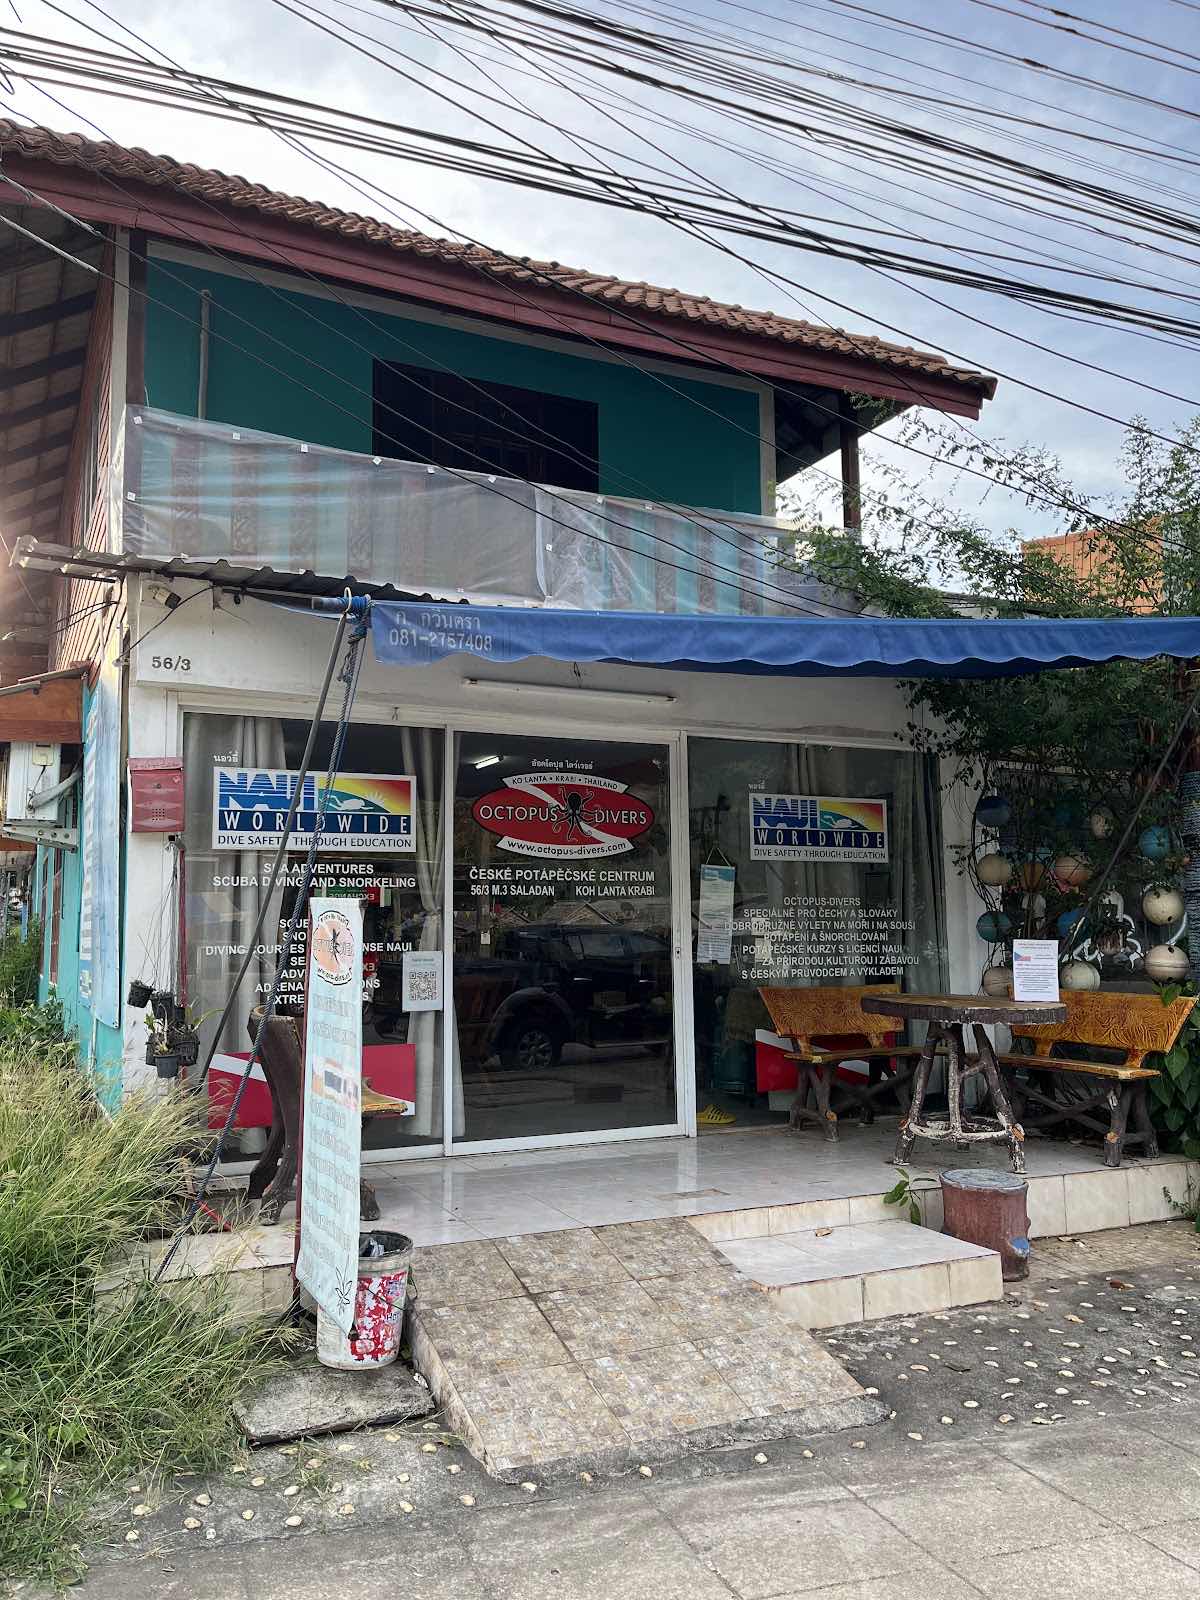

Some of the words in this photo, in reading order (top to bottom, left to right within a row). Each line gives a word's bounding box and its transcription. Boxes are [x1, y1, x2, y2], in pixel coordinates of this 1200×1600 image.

[390, 629, 492, 651] 081-2757408
[152, 656, 191, 671] 56/3
[584, 778, 618, 790] THAILAND
[479, 805, 559, 822] OCTOPUS
[595, 810, 647, 825] DIVERS
[753, 798, 817, 829] NAUI
[224, 811, 408, 834] WORLDWIDE
[218, 835, 244, 845] DIVE
[248, 836, 283, 846] SAFET
[351, 838, 411, 848] EDUCATION
[758, 829, 884, 847] WORLDWIDE
[507, 841, 627, 857] www.octopus-divers.com
[754, 848, 772, 856] DIVE
[774, 849, 801, 857] SAFETY
[804, 850, 841, 858] THROUGH
[843, 851, 886, 859] EDUCATION
[264, 863, 288, 873] SA
[292, 863, 374, 874] ADVENTURES
[469, 866, 512, 880] ČESKÉ
[516, 868, 597, 881] POTÁPĚČSKÉ
[600, 871, 655, 881] CENTRUM
[213, 876, 258, 887] SCUBA
[262, 876, 304, 887] DVING
[309, 877, 336, 887] AND
[341, 877, 416, 888] SNORKELING
[470, 885, 490, 895] 56/3
[492, 885, 508, 896] M.3
[510, 885, 555, 896] SALADAN
[575, 886, 595, 896] KOH
[598, 886, 626, 896] LANTA
[628, 886, 655, 896] KRABI
[783, 896, 861, 906] OCTOPUS-DIVERS
[798, 909, 817, 917] PRO
[819, 907, 849, 918] ČECHY
[850, 909, 857, 917] A
[797, 919, 831, 930] VÝLETY
[834, 920, 846, 929] NA
[848, 919, 870, 930] MOŘI
[877, 921, 889, 929] NA
[890, 920, 916, 931] SOUŠI
[811, 932, 818, 941] A
[819, 930, 889, 941] ŠNORCHLOVÁNÍ
[206, 944, 248, 956] DIVING
[386, 942, 412, 952] NAUI
[807, 944, 836, 953] KURZY
[838, 944, 845, 953] S
[847, 942, 880, 953] LICENCÍ
[882, 944, 903, 953] NAUI
[762, 957, 775, 966] ZA
[880, 954, 920, 965] ZÁBAVOU
[742, 970, 748, 979] S
[849, 968, 856, 977] A
